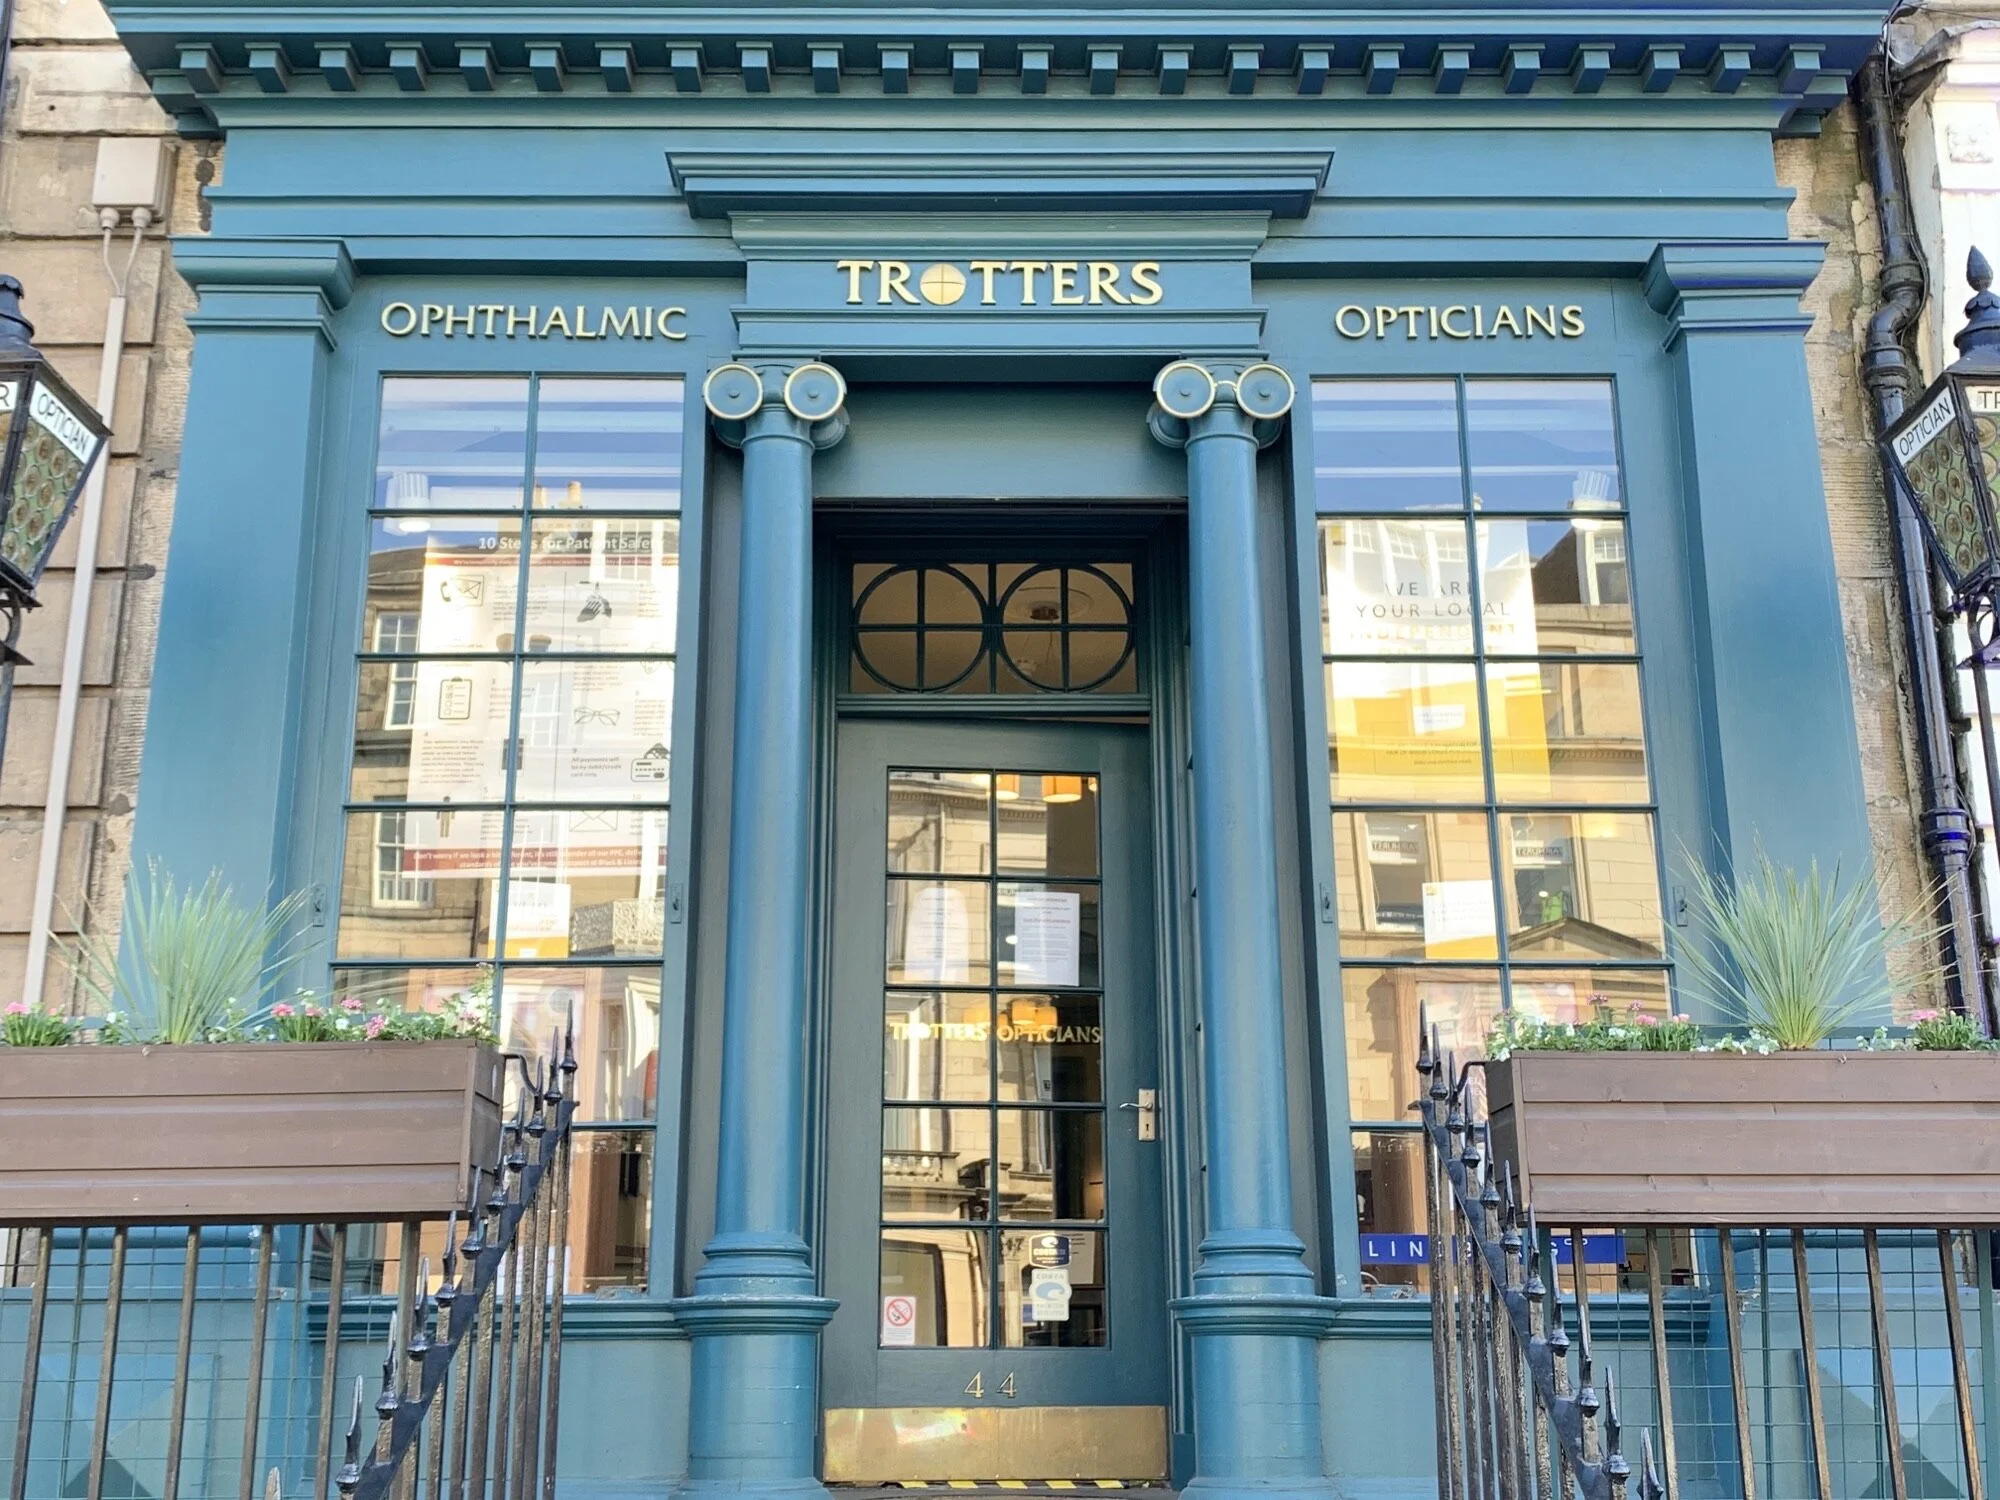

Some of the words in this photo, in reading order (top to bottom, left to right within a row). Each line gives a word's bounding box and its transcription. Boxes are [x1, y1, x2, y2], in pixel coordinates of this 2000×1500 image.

[837, 260, 1163, 305] TROTTERS
[381, 302, 687, 339] OPHTHALMIC
[1335, 305, 1585, 338] OPTICIANS
[37, 393, 89, 456] OPTICIAN
[1899, 398, 1951, 456] OPTICIAN
[479, 537, 497, 549] 10
[499, 537, 537, 550] Stes
[543, 535, 563, 550] for
[566, 536, 618, 550] Patint
[620, 536, 660, 550] Safe
[1356, 604, 1421, 618] YOUR
[997, 1025, 1100, 1043] OPTICIANS
